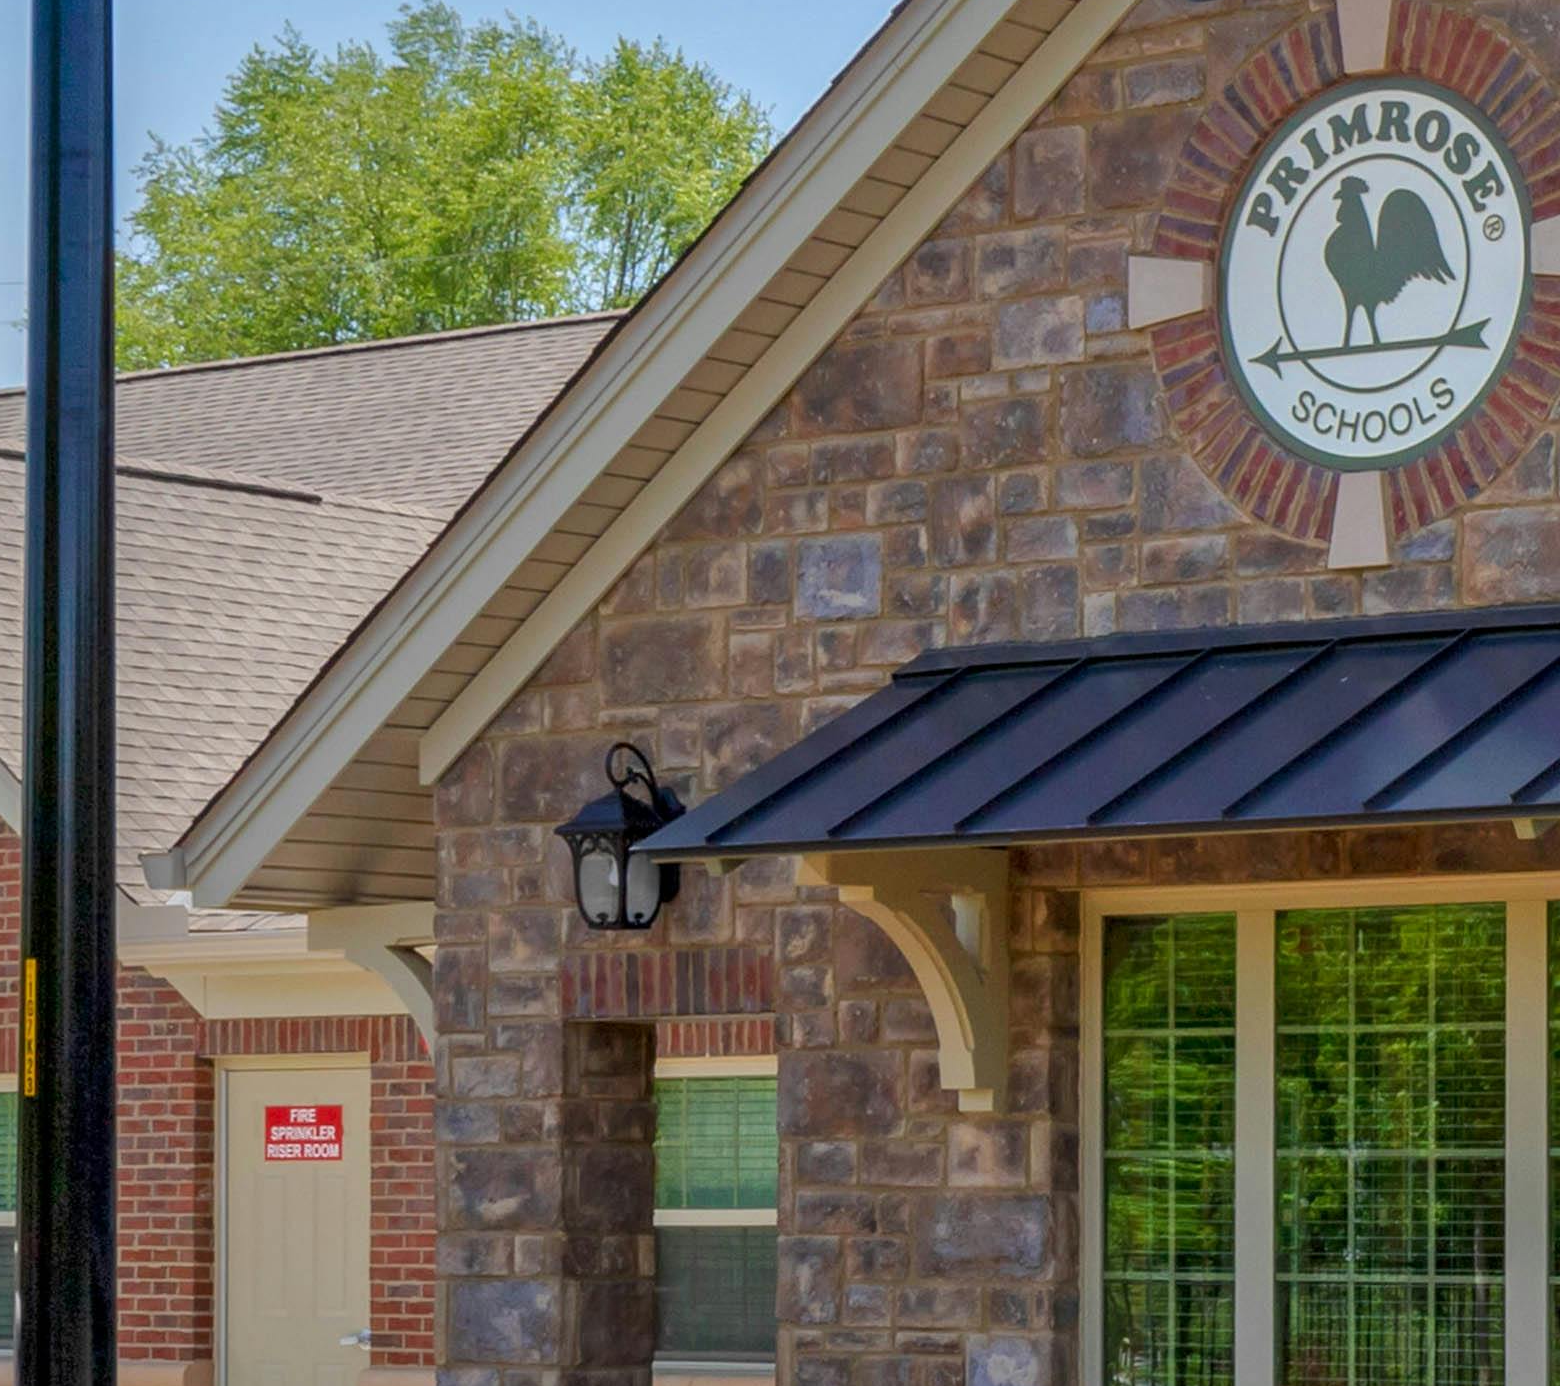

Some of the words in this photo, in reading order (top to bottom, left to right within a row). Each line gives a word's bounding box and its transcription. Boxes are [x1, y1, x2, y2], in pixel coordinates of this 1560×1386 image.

[1292, 377, 1455, 443] SCHOOLS
[290, 1108, 317, 1123] FIRE
[270, 1125, 336, 1141] SPRINKLER
[267, 1144, 301, 1158] RISER
[304, 1143, 339, 1158] ROOM
